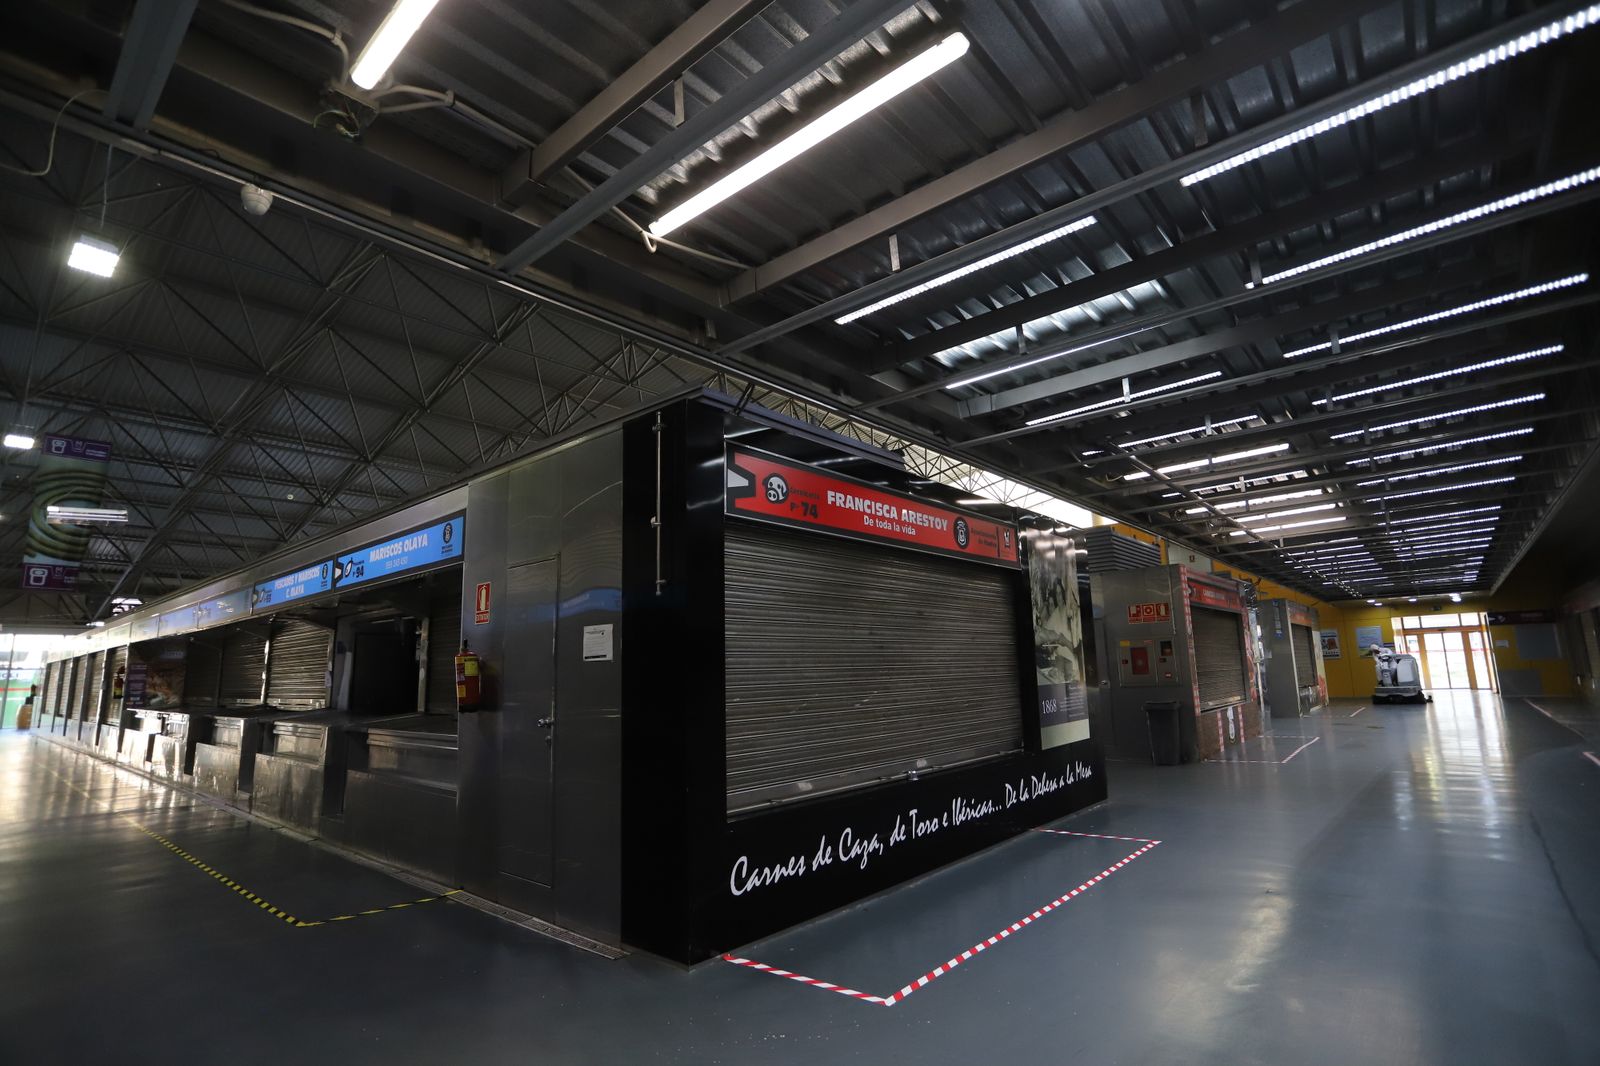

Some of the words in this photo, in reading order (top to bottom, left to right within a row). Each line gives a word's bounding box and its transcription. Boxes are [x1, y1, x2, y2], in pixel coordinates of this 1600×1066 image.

[801, 501, 818, 519] 74
[827, 490, 898, 520] FRANCISCA
[901, 509, 948, 531] ARESTOY
[863, 515, 874, 527] De
[876, 518, 892, 530] toda
[893, 522, 900, 532] la
[902, 524, 916, 536] vida
[369, 541, 403, 563] MARISCOS
[404, 533, 428, 553] OLAYA
[356, 565, 364, 578] 94
[1041, 698, 1057, 715] 1868
[730, 855, 806, 896] Carnes
[812, 834, 833, 872] de
[839, 827, 884, 870] Caza,
[889, 814, 906, 847] de
[909, 808, 939, 840] Toro
[942, 812, 949, 827] e
[1005, 783, 1017, 809] De
[1019, 778, 1030, 802] la
[1031, 771, 1058, 800] Dehesa
[1059, 775, 1065, 788] a
[1066, 763, 1074, 785] la
[1075, 760, 1092, 782] Mesa
